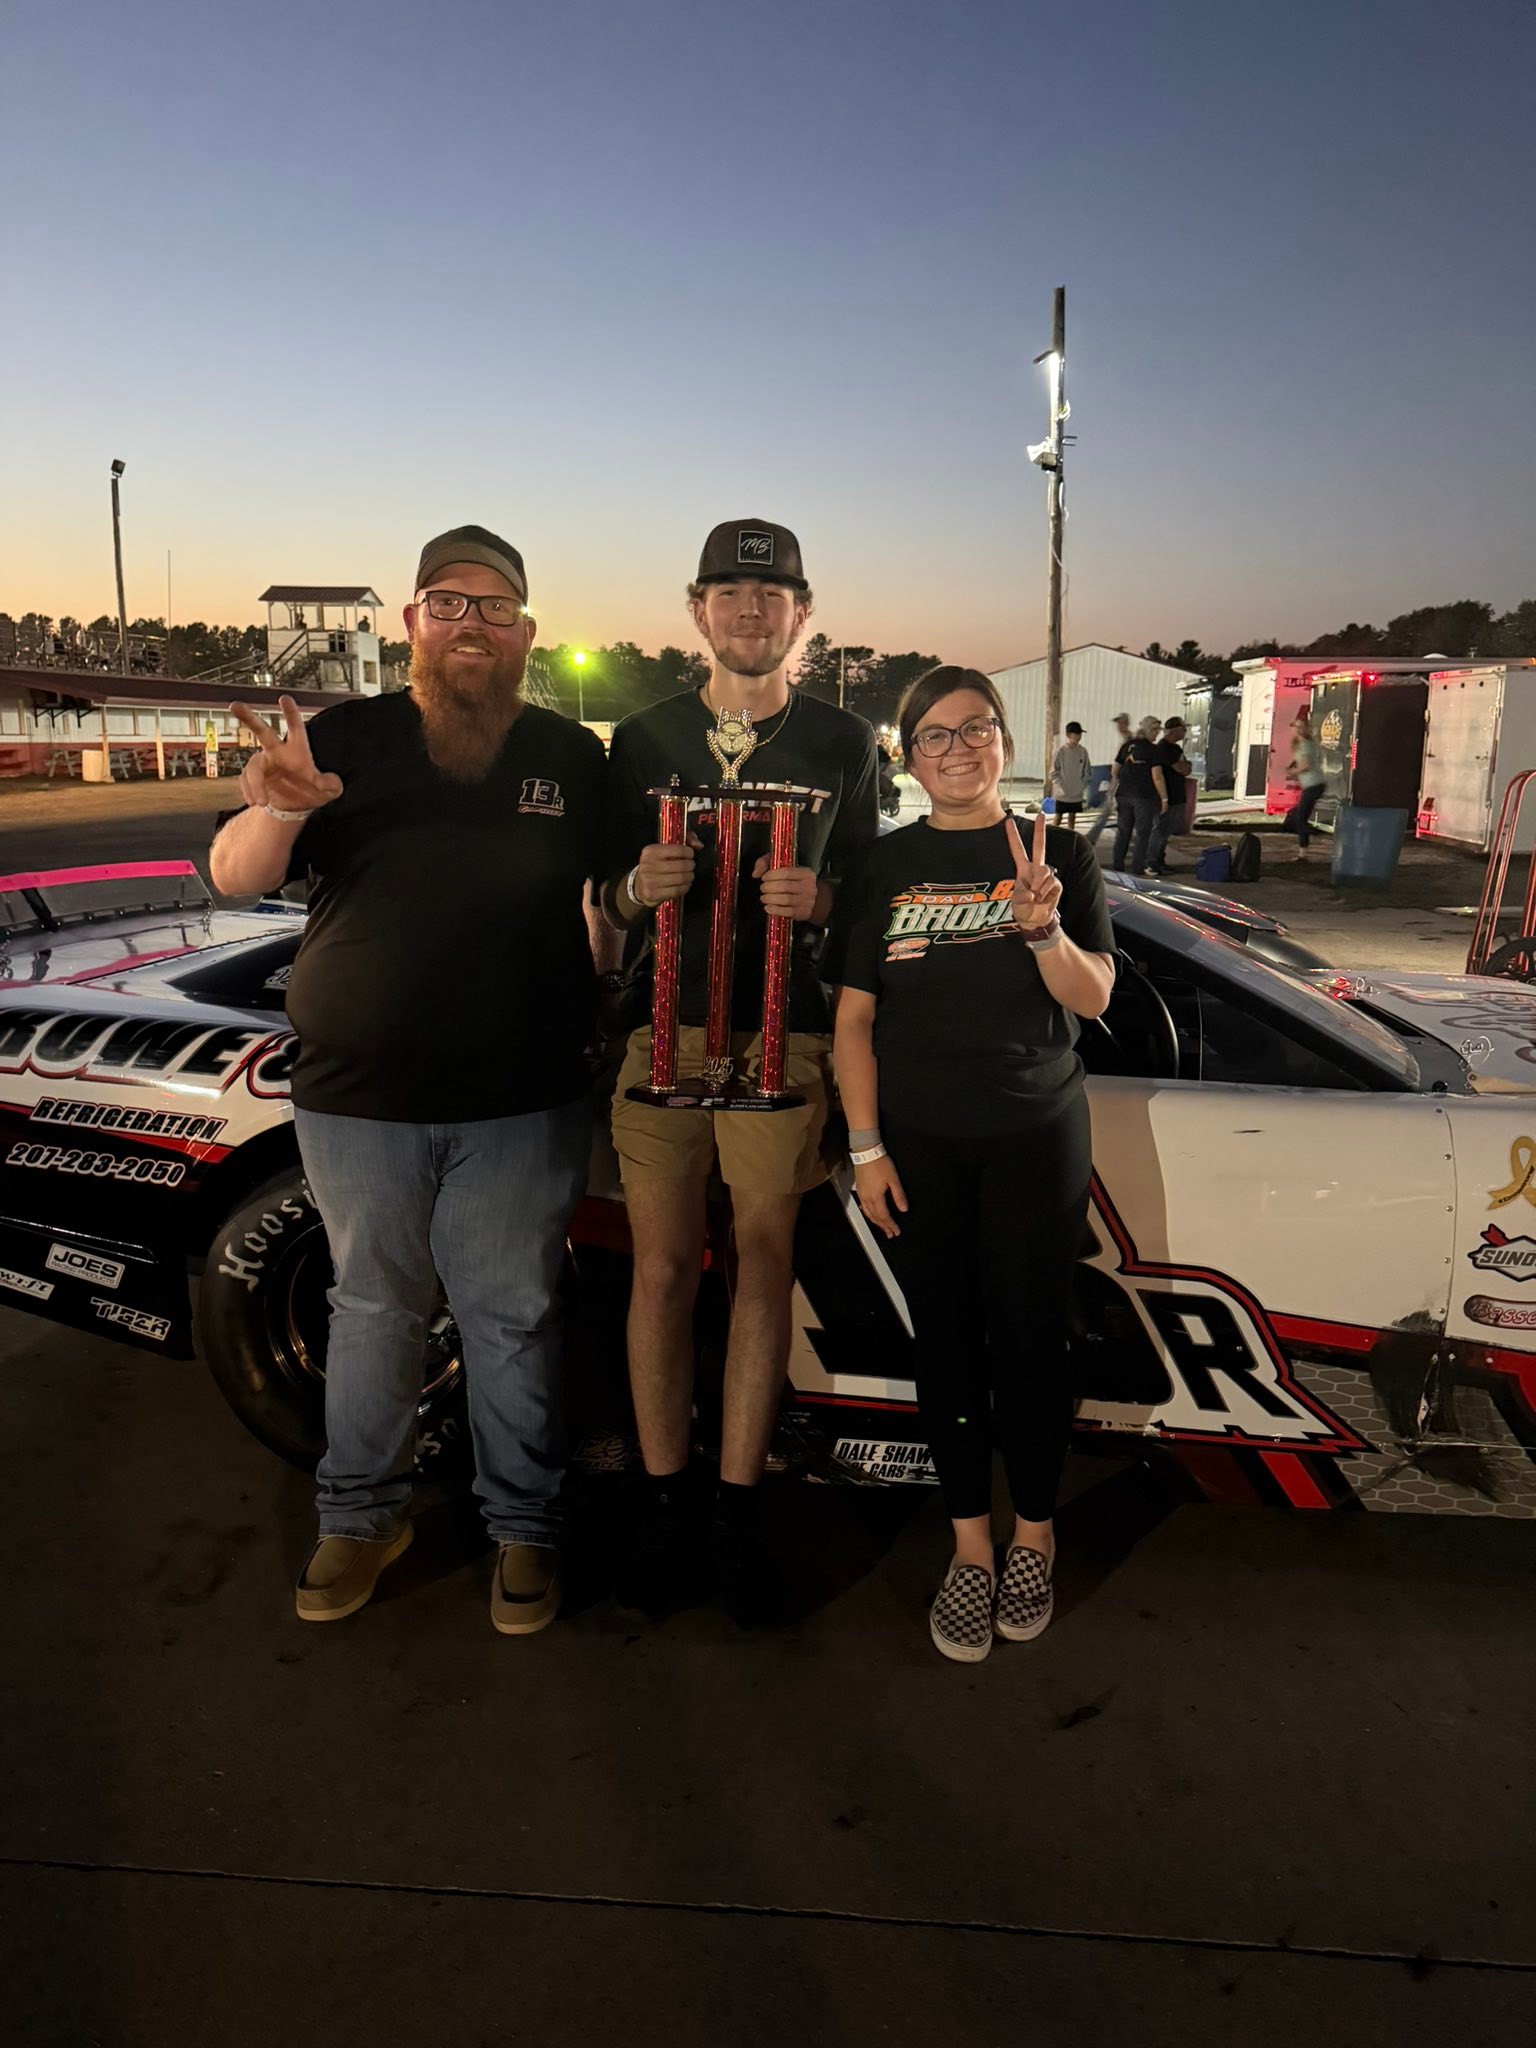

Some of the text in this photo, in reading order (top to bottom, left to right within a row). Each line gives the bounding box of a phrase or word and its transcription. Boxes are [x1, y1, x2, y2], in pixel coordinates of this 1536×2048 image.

[922, 894, 974, 903] DAN
[888, 899, 1014, 937] BROW
[704, 1056, 734, 1075] 2025
[33, 1098, 226, 1142] REFRIGERATION
[7, 1144, 185, 1185] 207-283-2050
[218, 1178, 317, 1293] Hoosi
[54, 1251, 118, 1278] JOES
[1479, 1250, 1536, 1266] SUNO
[0, 1271, 48, 1291] wift
[92, 1298, 170, 1336] TIGER
[1472, 1302, 1536, 1325] Basse
[837, 1442, 880, 1461] DALE
[870, 1463, 907, 1478] CARS
